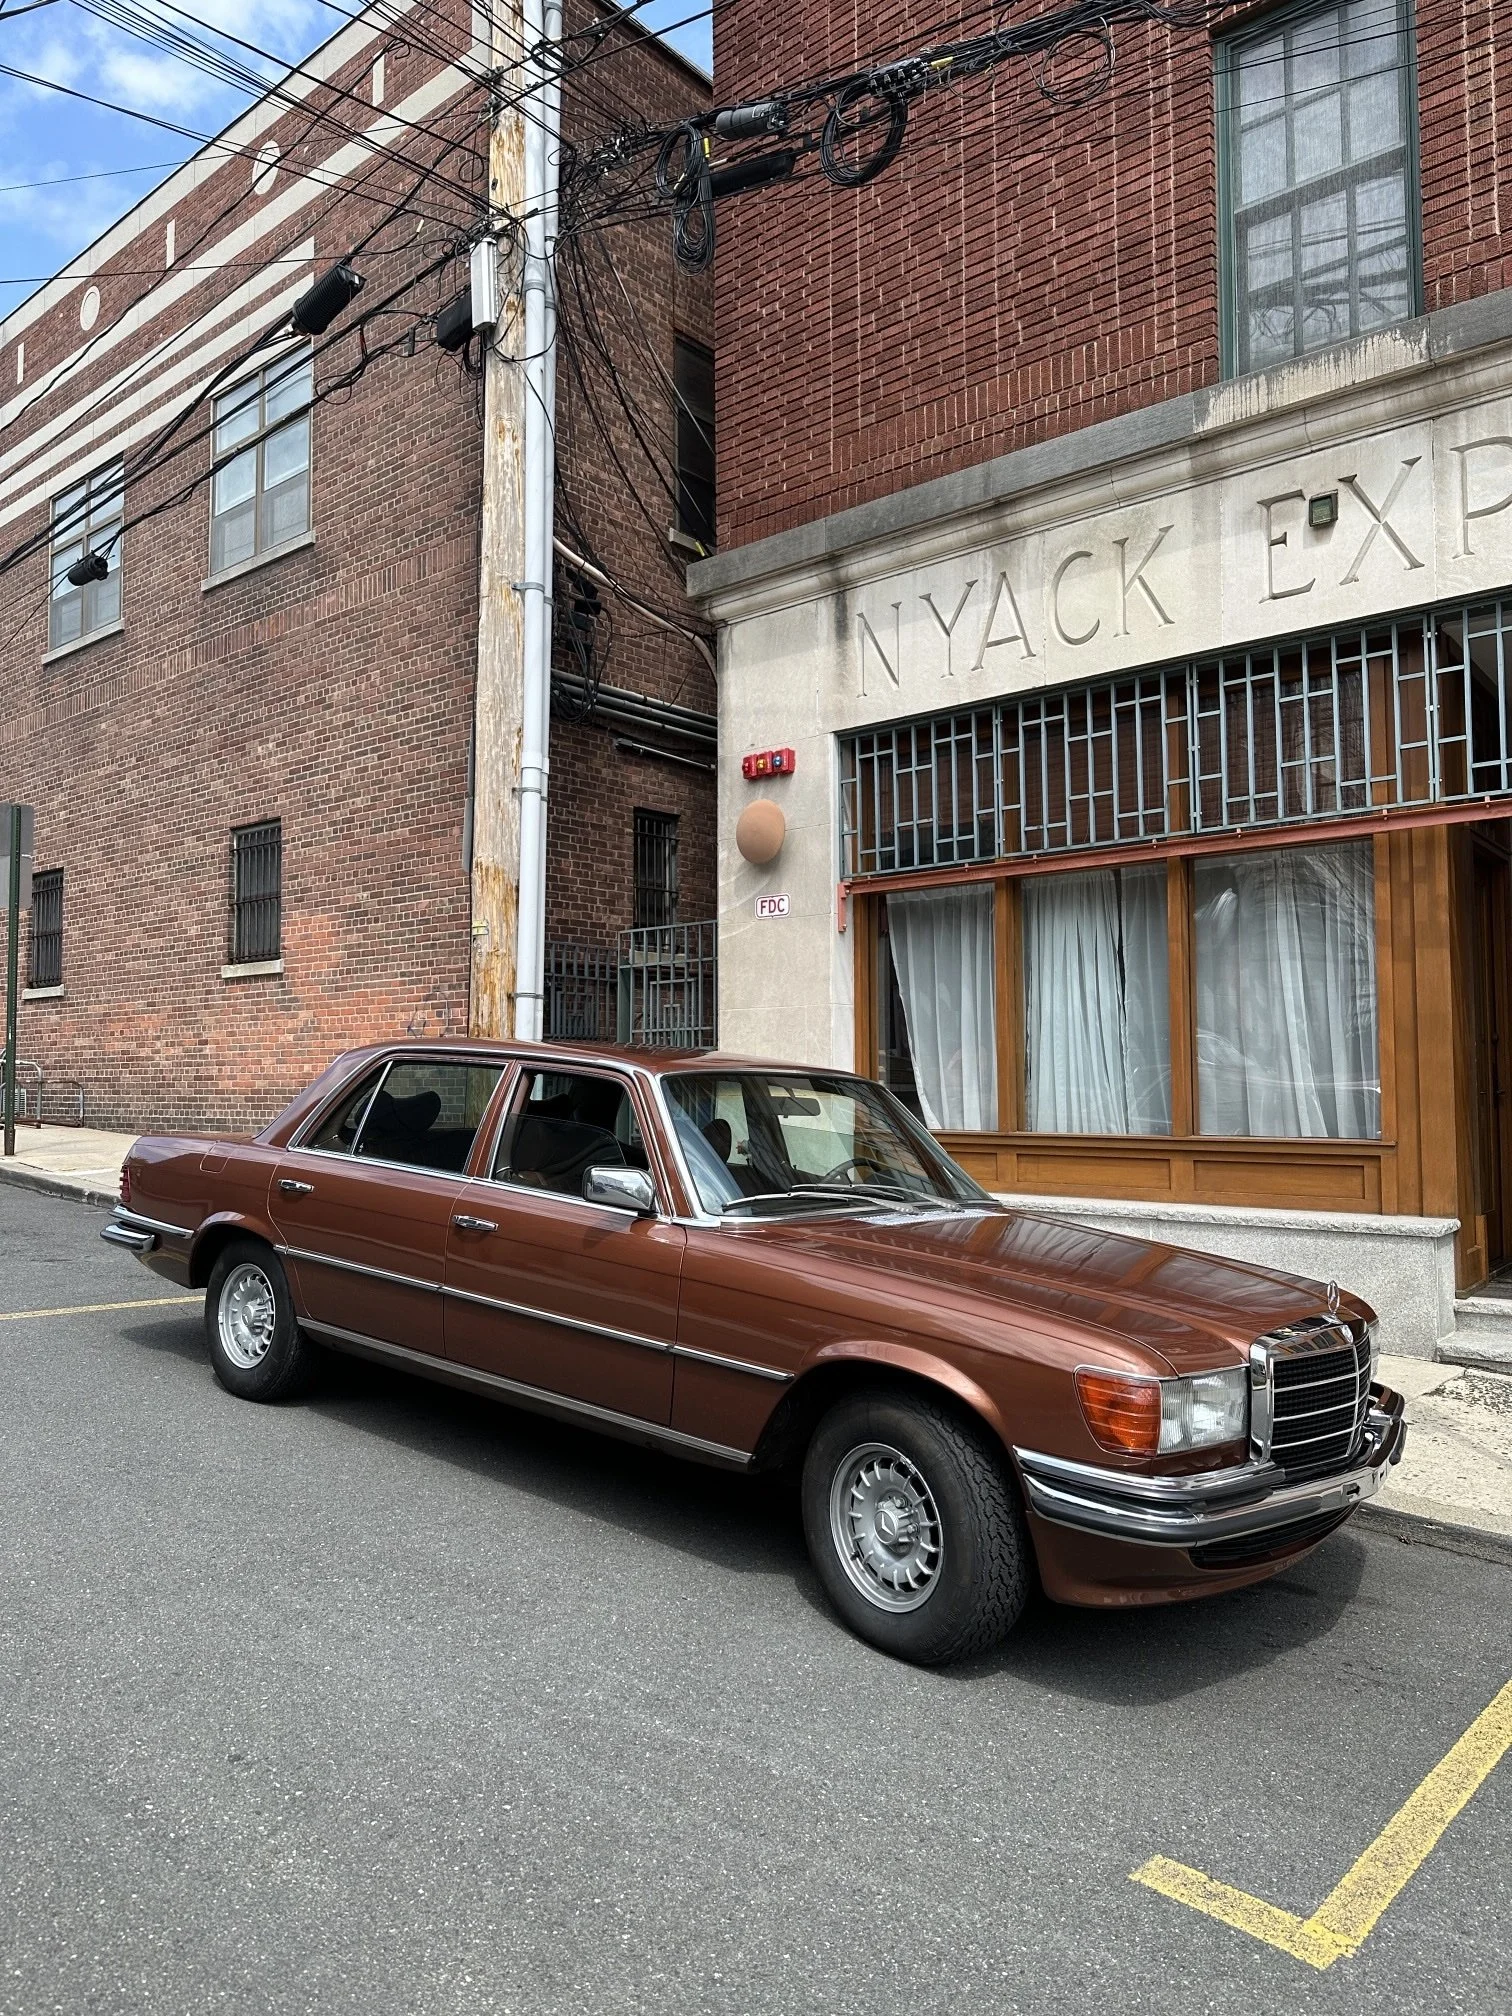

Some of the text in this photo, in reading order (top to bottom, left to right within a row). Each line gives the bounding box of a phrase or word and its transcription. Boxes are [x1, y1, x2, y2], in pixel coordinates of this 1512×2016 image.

[856, 436, 1512, 698] NYACK EXP
[760, 897, 785, 914] FDC
